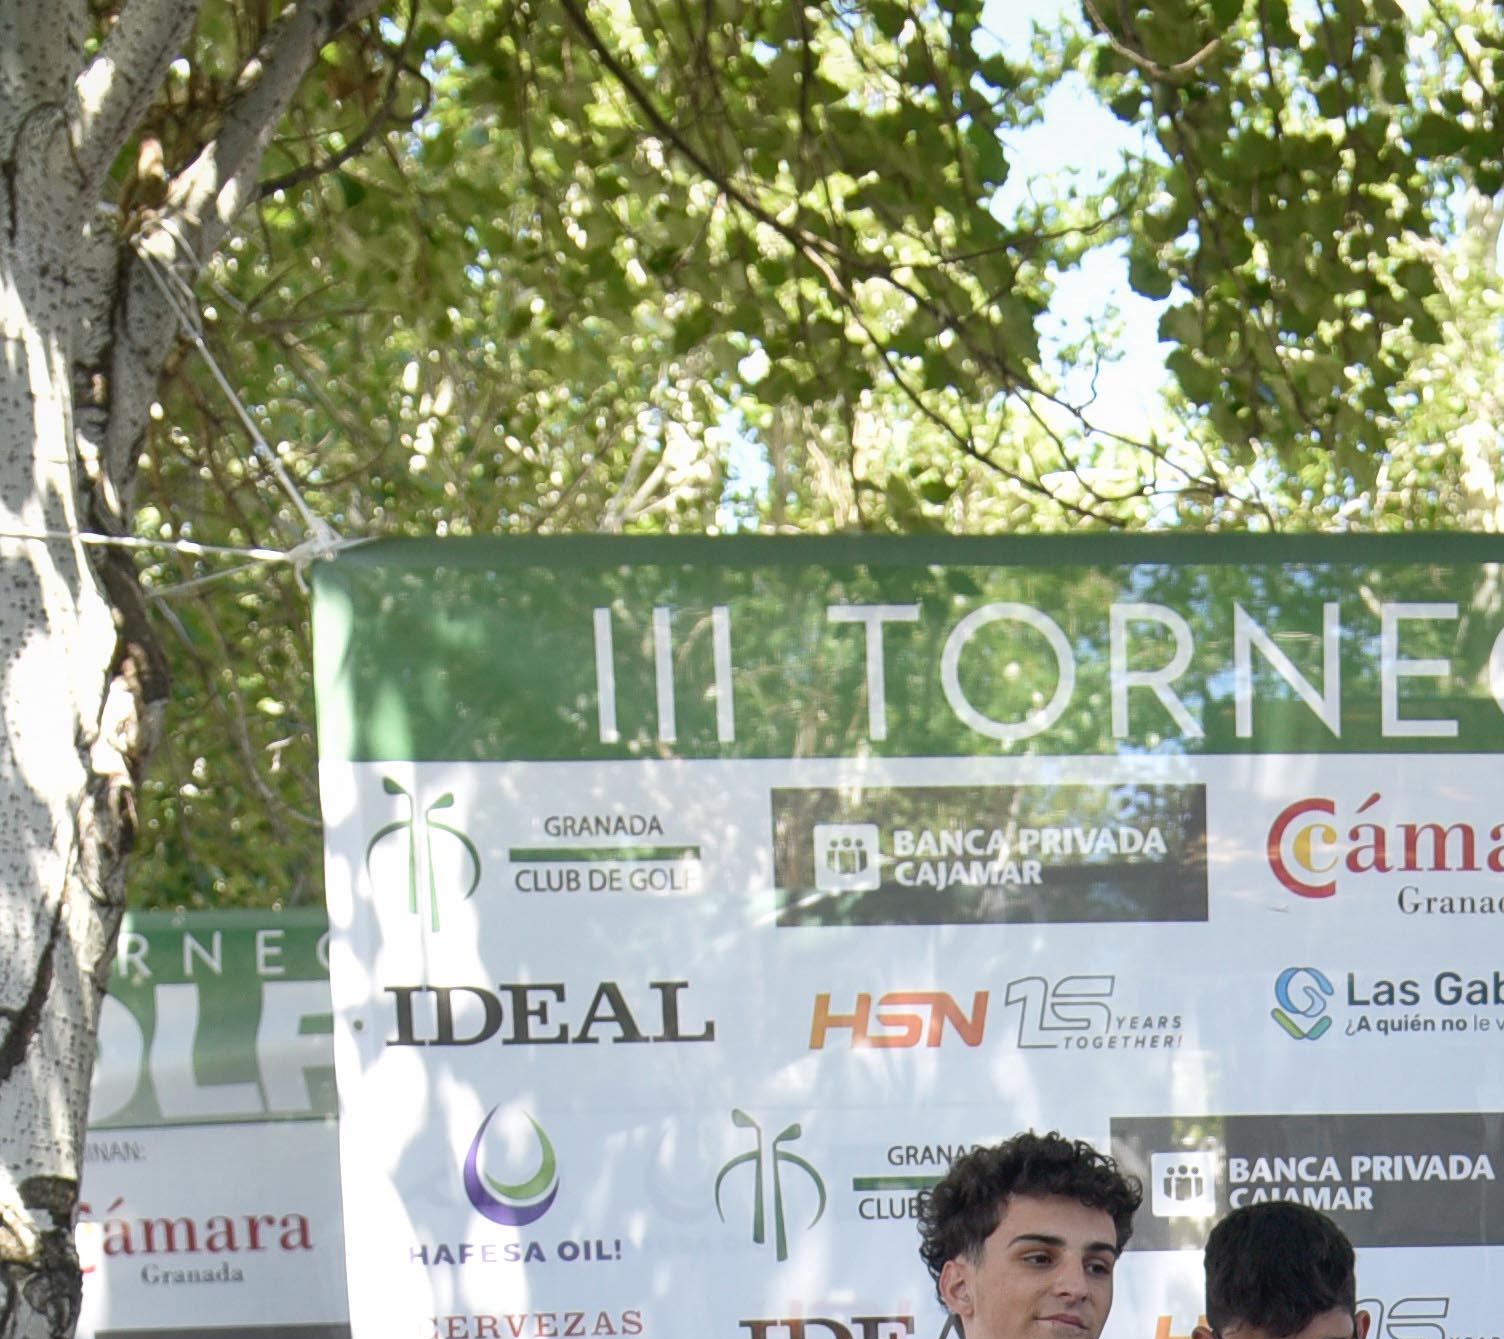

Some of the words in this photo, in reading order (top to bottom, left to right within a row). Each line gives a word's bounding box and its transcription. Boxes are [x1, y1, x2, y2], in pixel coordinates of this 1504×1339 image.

[593, 605, 735, 744] III
[543, 814, 664, 837] GRANADA
[894, 828, 1011, 857] BANCA
[1020, 827, 1168, 855] PRIVADA
[514, 867, 582, 893] CLUB
[588, 867, 624, 892] DE
[630, 866, 695, 891] GOLF
[894, 860, 1044, 888] CAJAMAR
[118, 930, 331, 976] RNE
[1346, 971, 1422, 1008] Las
[385, 981, 715, 1047] IDEAL
[808, 990, 990, 1050] HSN
[1115, 1015, 1183, 1031] YEARS
[1344, 1016, 1371, 1037] ¿A
[1376, 1013, 1436, 1037] quién
[1441, 1017, 1468, 1033] no
[1472, 1014, 1491, 1032] le
[1063, 1034, 1183, 1051] TOGETHER!
[1228, 1155, 1342, 1184] BANCA
[1351, 1154, 1495, 1182] PRIVADA
[86, 1196, 315, 1264] ámara
[408, 1240, 545, 1266] HAFESA
[556, 1238, 623, 1262] OIL!
[141, 1261, 244, 1285] Granada
